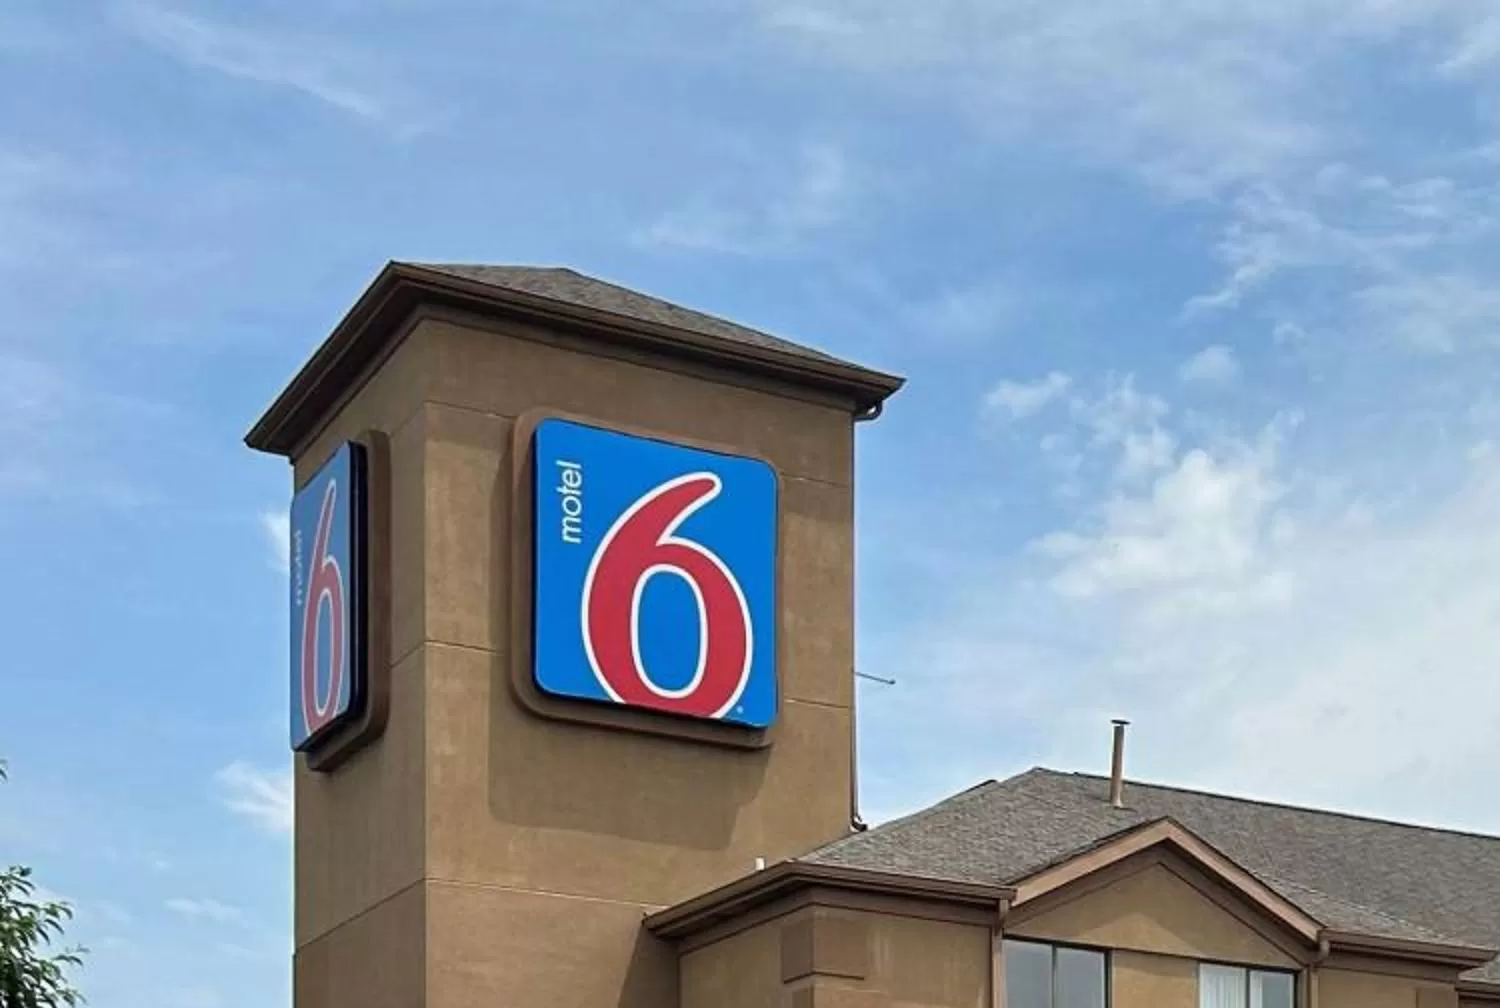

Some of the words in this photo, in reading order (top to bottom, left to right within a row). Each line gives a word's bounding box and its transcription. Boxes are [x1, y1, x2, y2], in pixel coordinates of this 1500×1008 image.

[301, 478, 345, 736] 6
[555, 459, 583, 544] motel
[581, 471, 753, 718] 6
